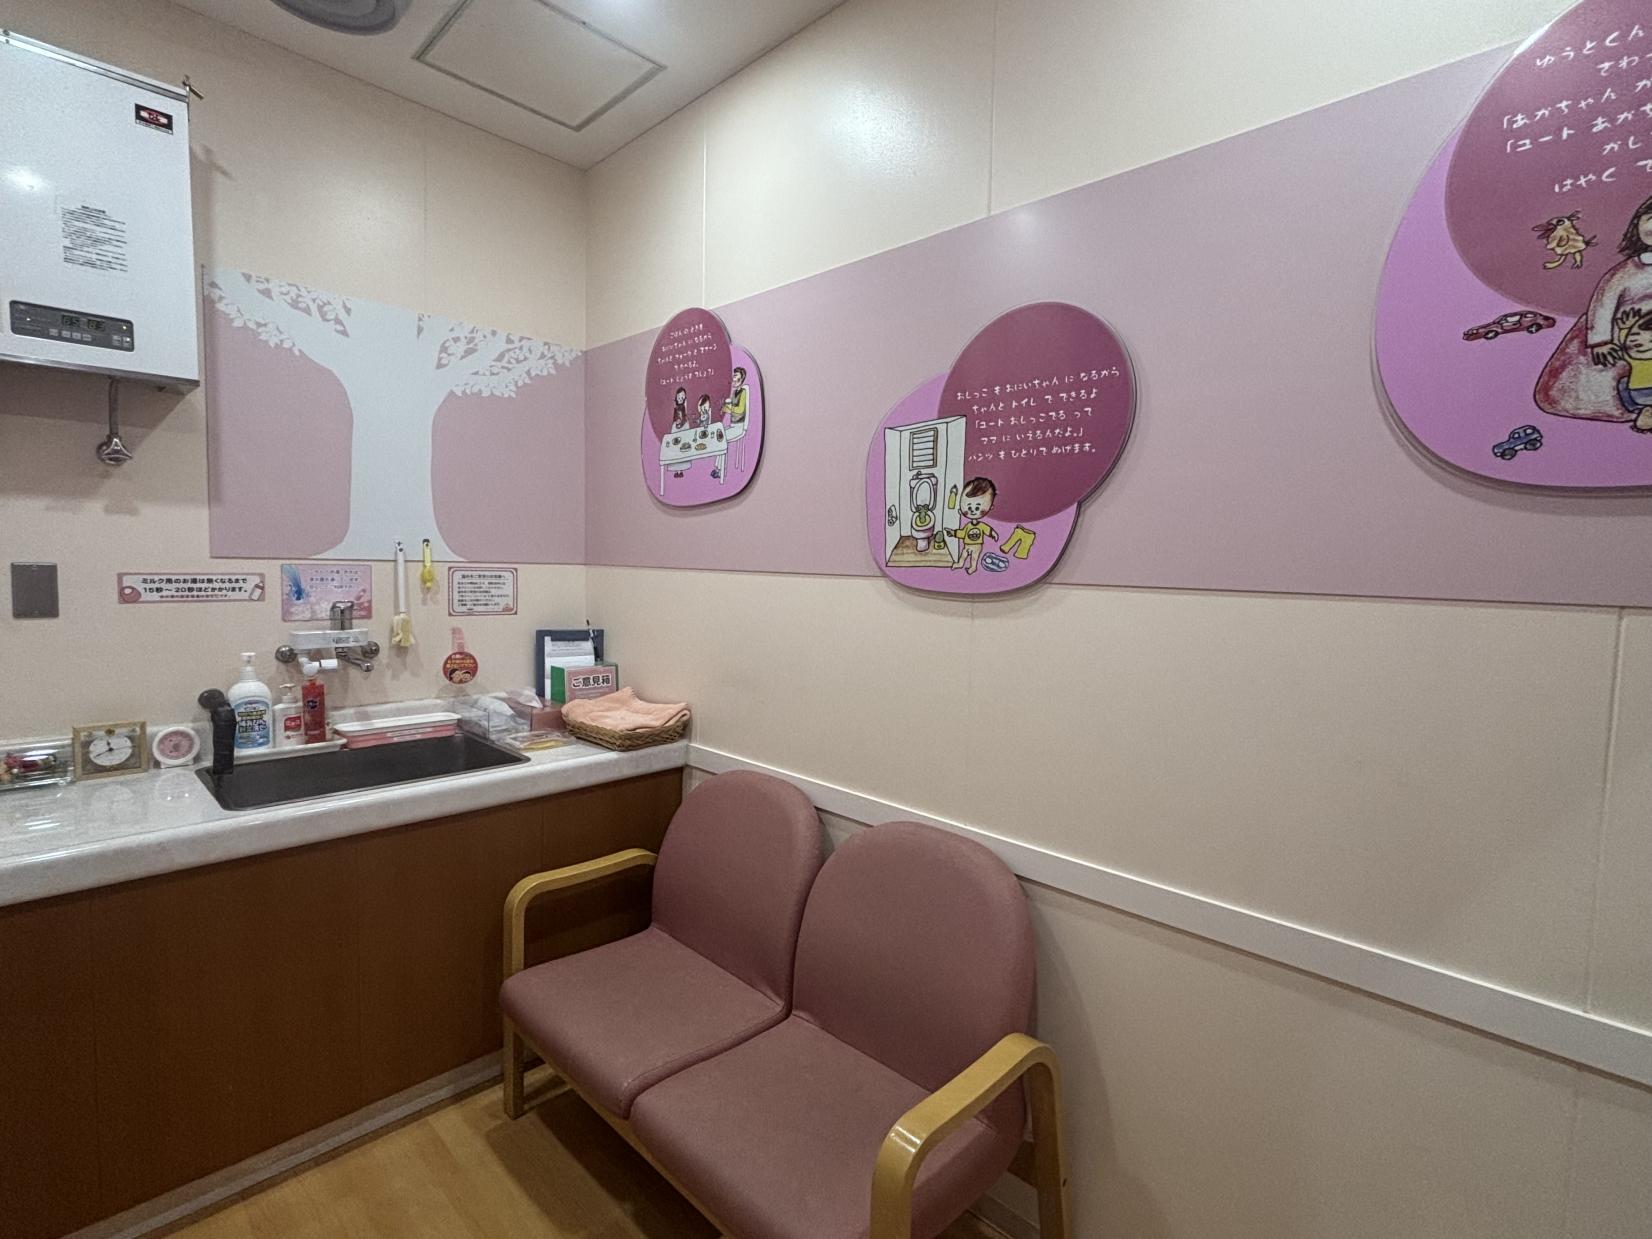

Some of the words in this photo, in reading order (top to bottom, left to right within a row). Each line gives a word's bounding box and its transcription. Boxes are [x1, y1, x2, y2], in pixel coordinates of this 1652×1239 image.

[1536, 25, 1644, 67] ゆうとくん
[1596, 53, 1652, 76] さわ
[1555, 167, 1617, 192] はやく
[957, 388, 988, 400] おしっこ
[1006, 376, 1059, 392] おにいちゃん
[1065, 375, 1075, 383] に
[1080, 366, 1119, 381] なるから
[972, 402, 1004, 414] ちゃんと
[1003, 434, 1011, 442] に
[573, 675, 611, 688] ご意見箱
